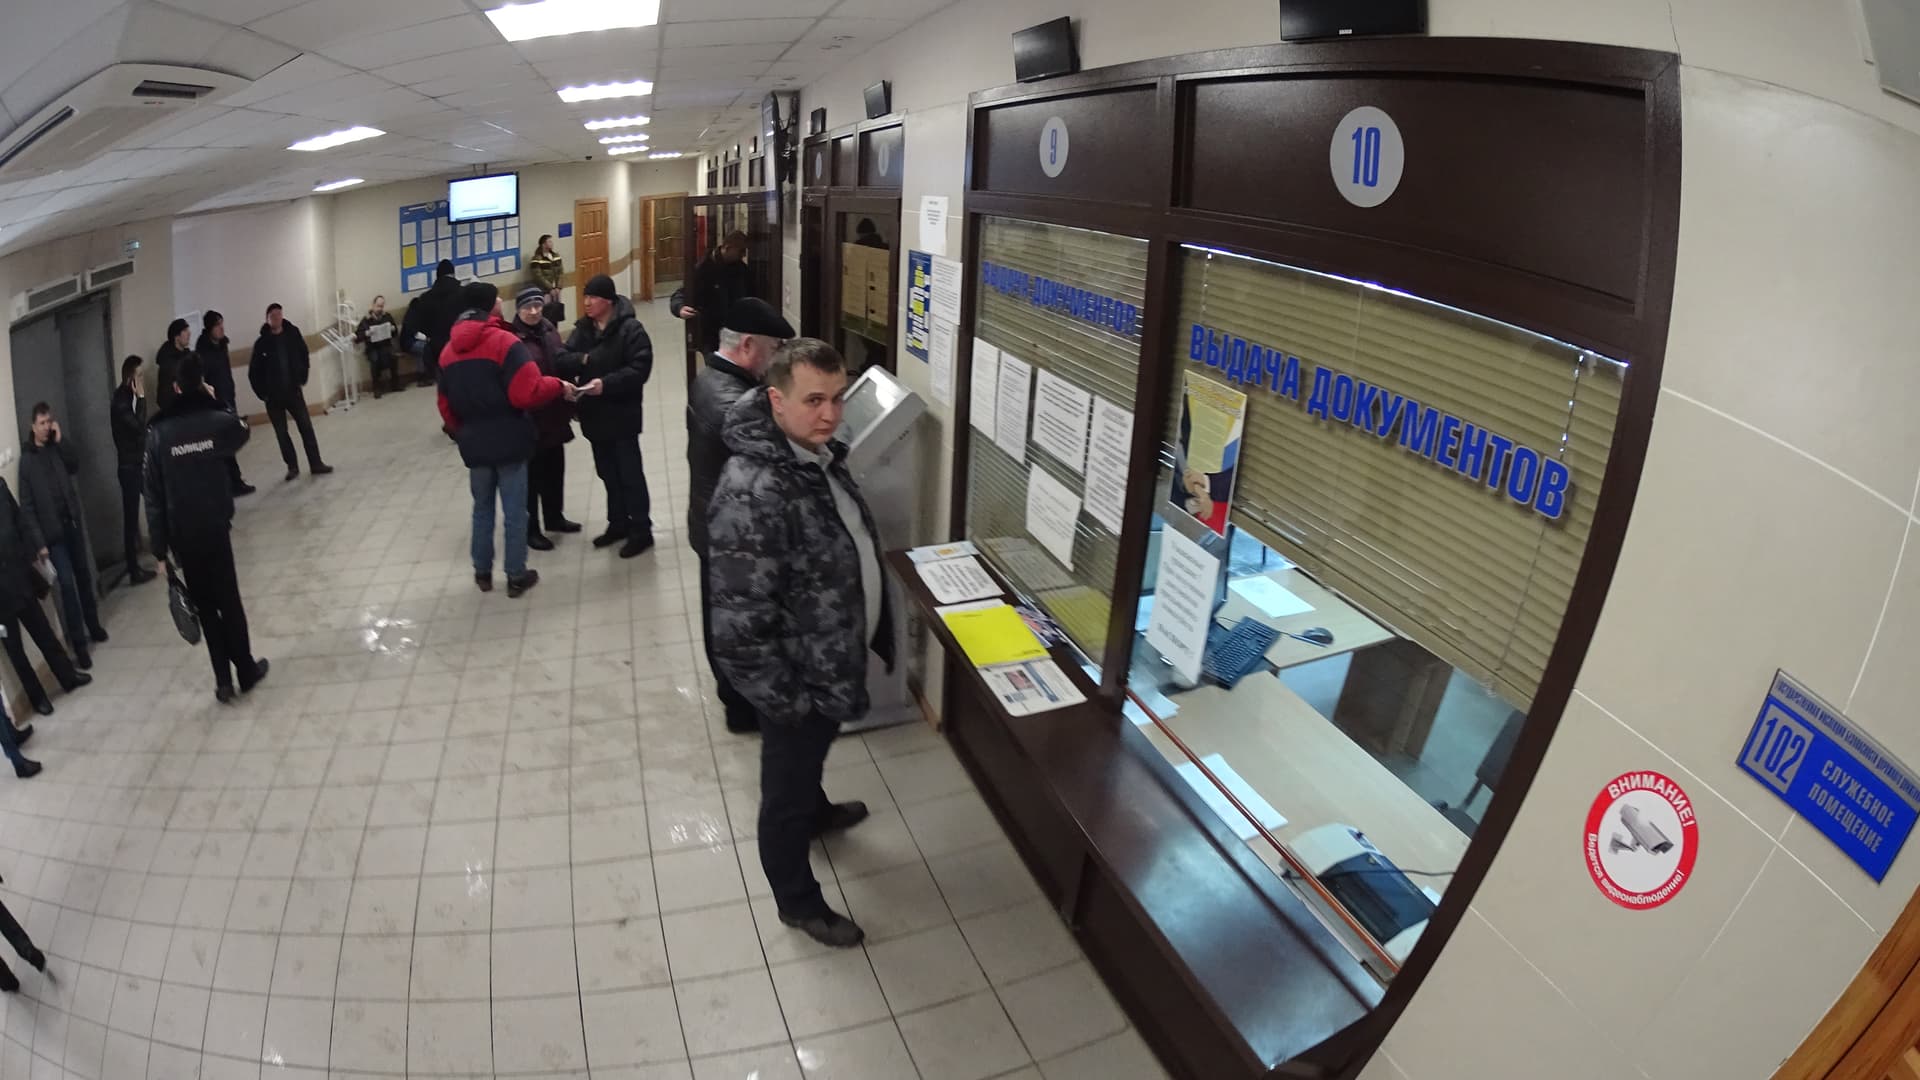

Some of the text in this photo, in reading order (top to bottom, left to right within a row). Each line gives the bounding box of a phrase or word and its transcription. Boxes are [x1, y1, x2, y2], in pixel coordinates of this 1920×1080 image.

[1050, 128, 1058, 165] 9
[1351, 126, 1381, 187] 10
[1030, 275, 1137, 337] ДОКУМЕНТОВ
[171, 439, 214, 457] ПОЛИЦИЯ
[1189, 322, 1571, 520] ВЫДАЧА ДОКУМЕНТОВ
[1753, 716, 1807, 785] 102
[1606, 774, 1696, 828] ВНИМАНИЕ!
[1807, 782, 1884, 854] ПОМЕЩЕНИЕ
[1821, 759, 1896, 829] СЛУЖЕБНОЕ
[1600, 868, 1686, 905] видеонаблюдение!
